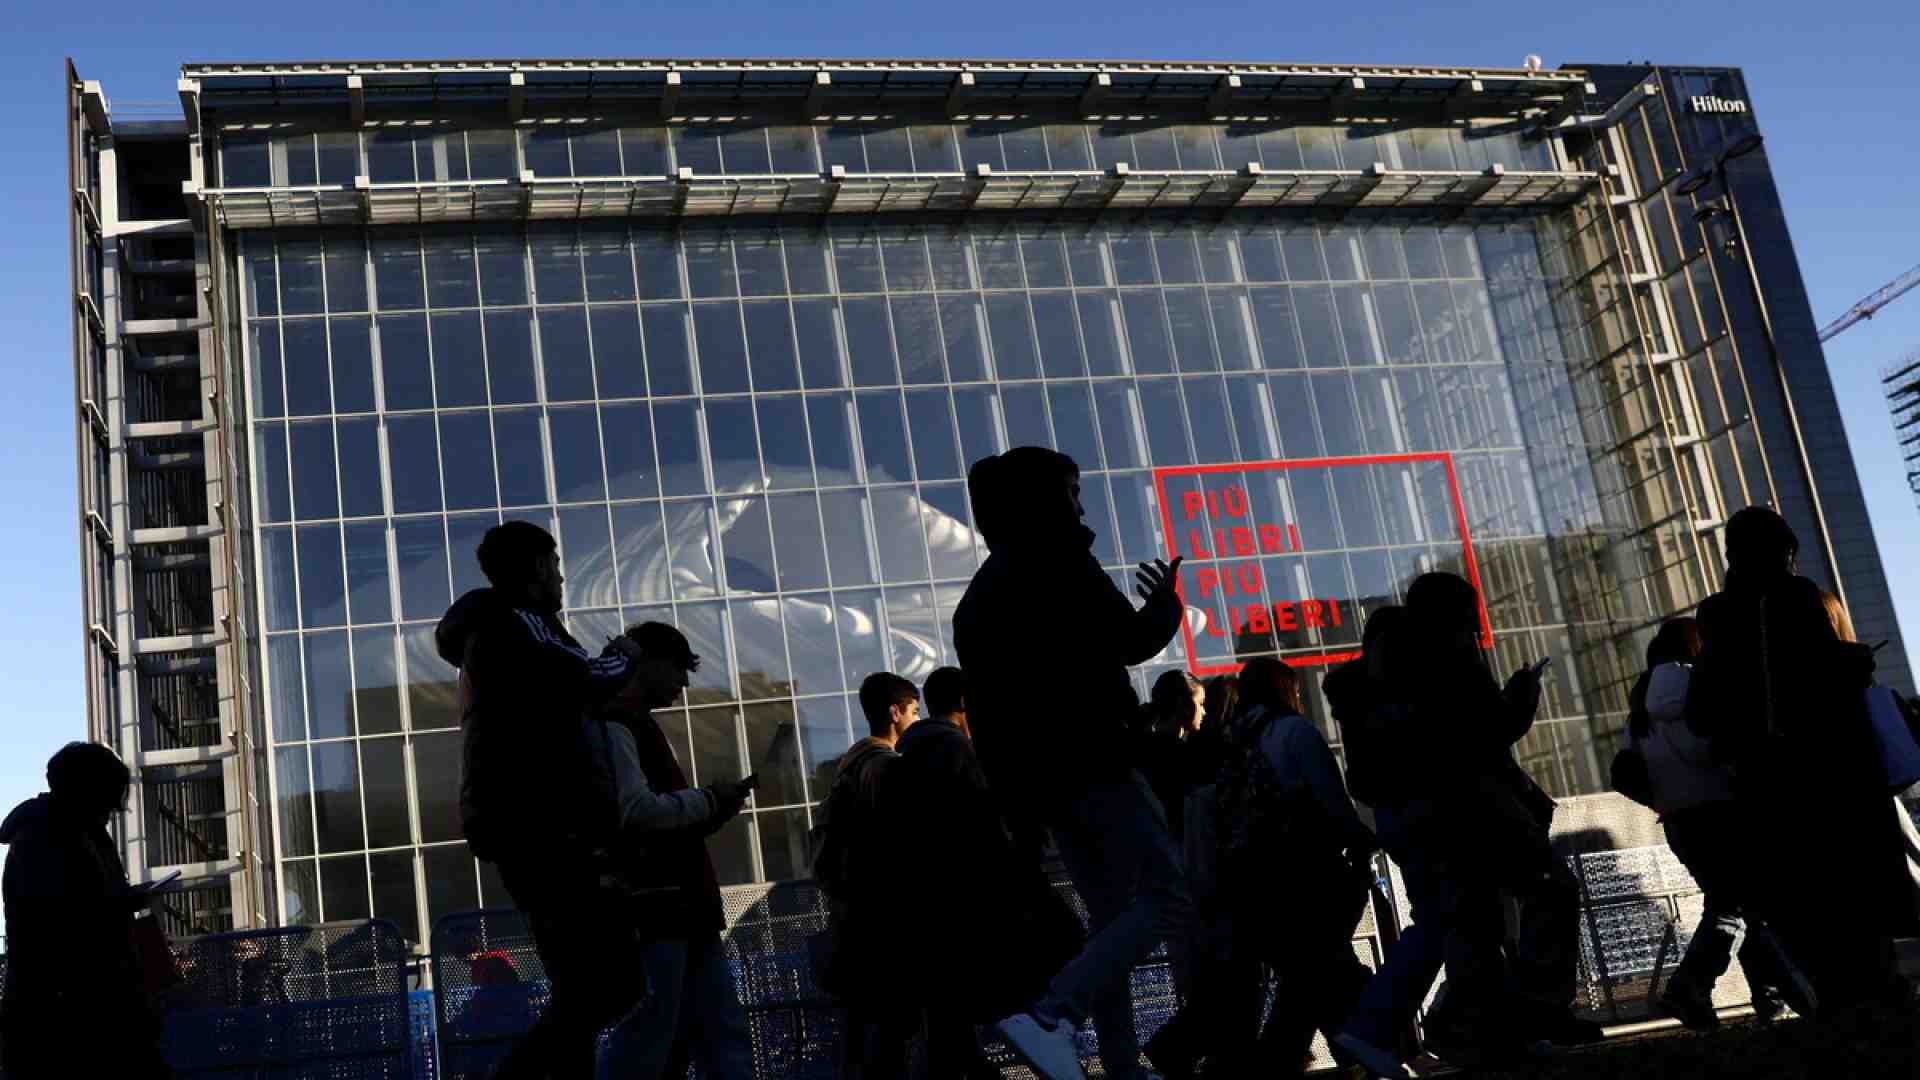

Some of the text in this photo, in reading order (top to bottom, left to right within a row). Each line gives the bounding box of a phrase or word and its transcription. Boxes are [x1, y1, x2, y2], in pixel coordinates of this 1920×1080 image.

[1691, 95, 1746, 112] Hilton
[1190, 523, 1301, 560] LIBRI
[1207, 597, 1344, 638] LIBERI
